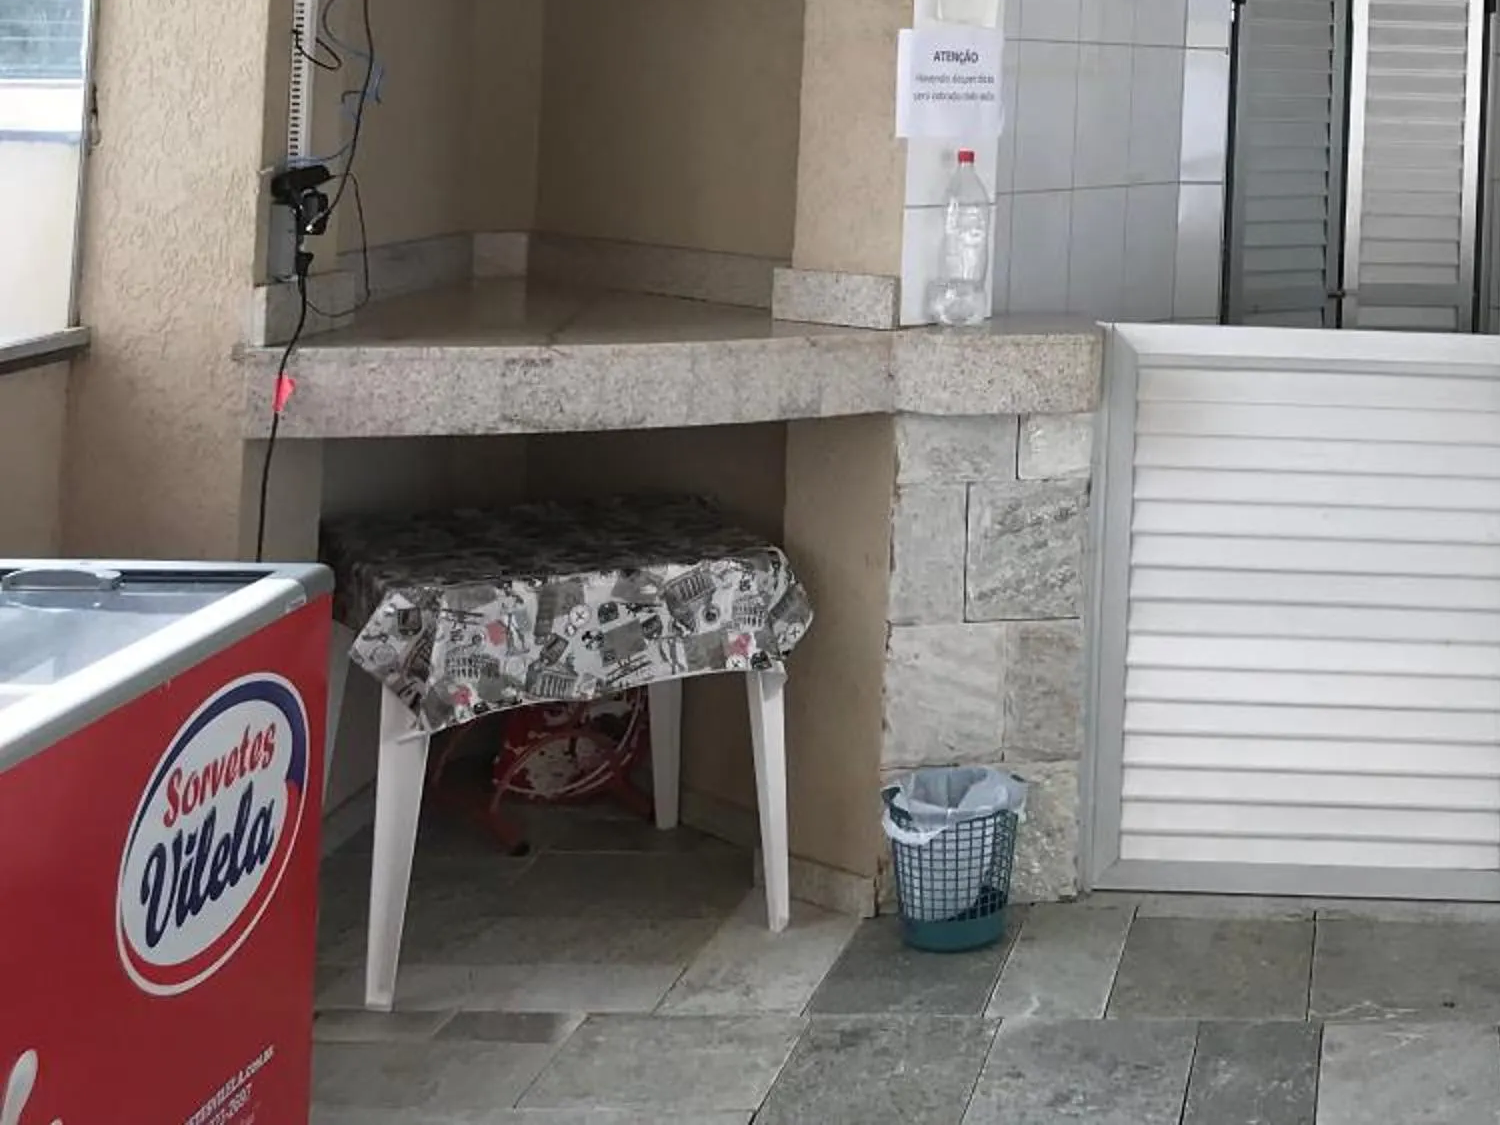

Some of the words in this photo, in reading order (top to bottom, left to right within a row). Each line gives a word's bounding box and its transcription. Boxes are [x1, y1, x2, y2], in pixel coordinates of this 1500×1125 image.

[934, 49, 979, 65] ATENÇÃO
[163, 722, 276, 828] Sorvetes
[140, 780, 275, 948] Vilela
